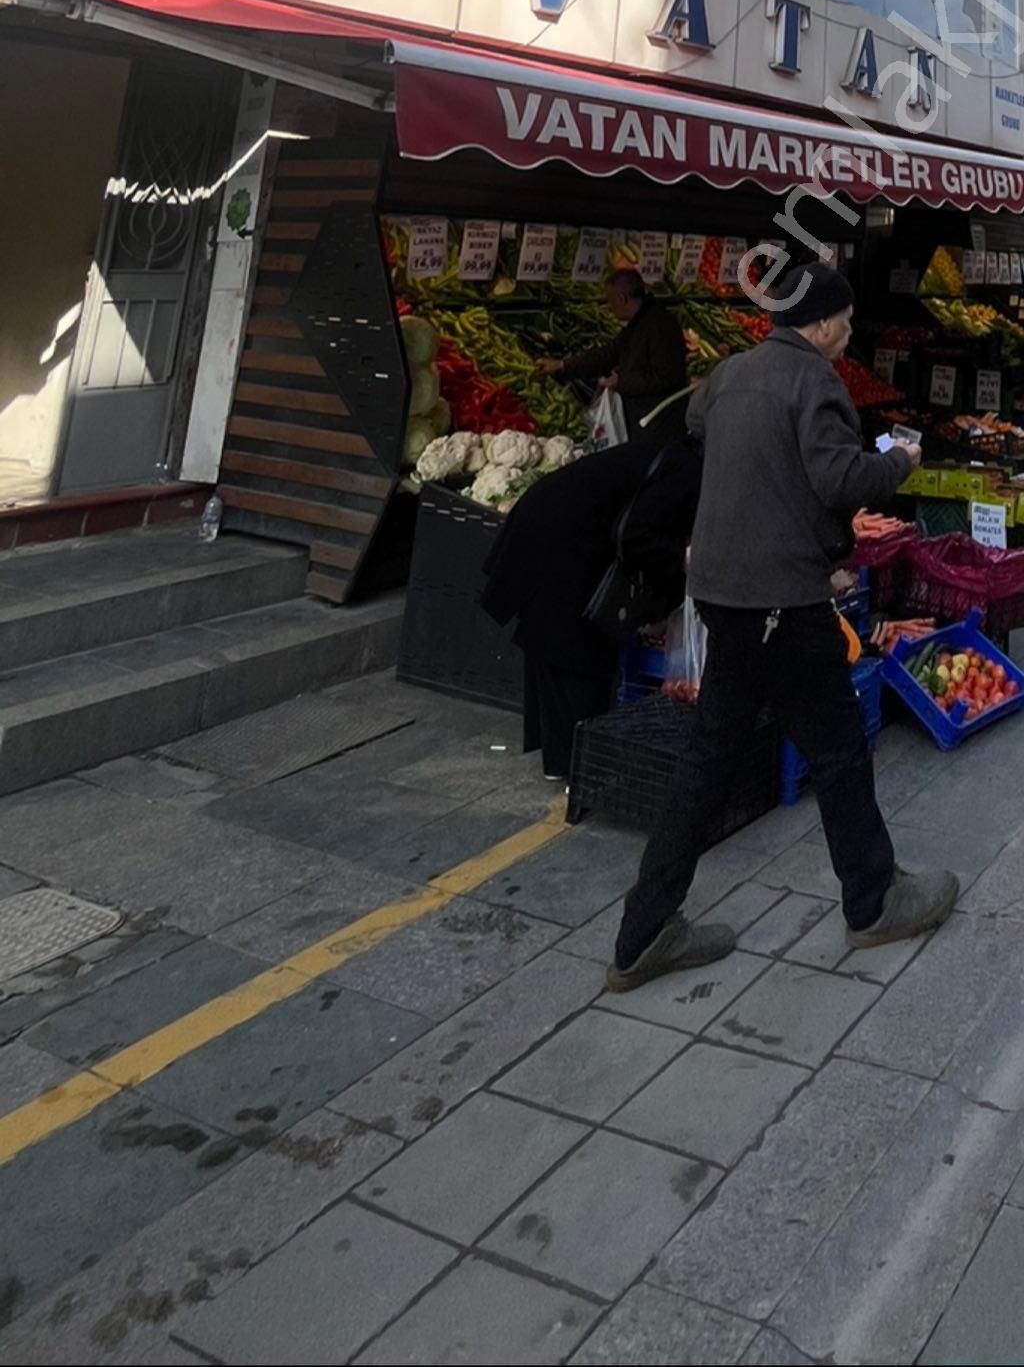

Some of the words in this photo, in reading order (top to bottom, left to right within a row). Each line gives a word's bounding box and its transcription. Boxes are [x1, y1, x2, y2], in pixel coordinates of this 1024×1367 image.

[496, 87, 687, 162] VATAN
[708, 126, 932, 190] MARKETLER
[941, 163, 1024, 203] GRUBU
